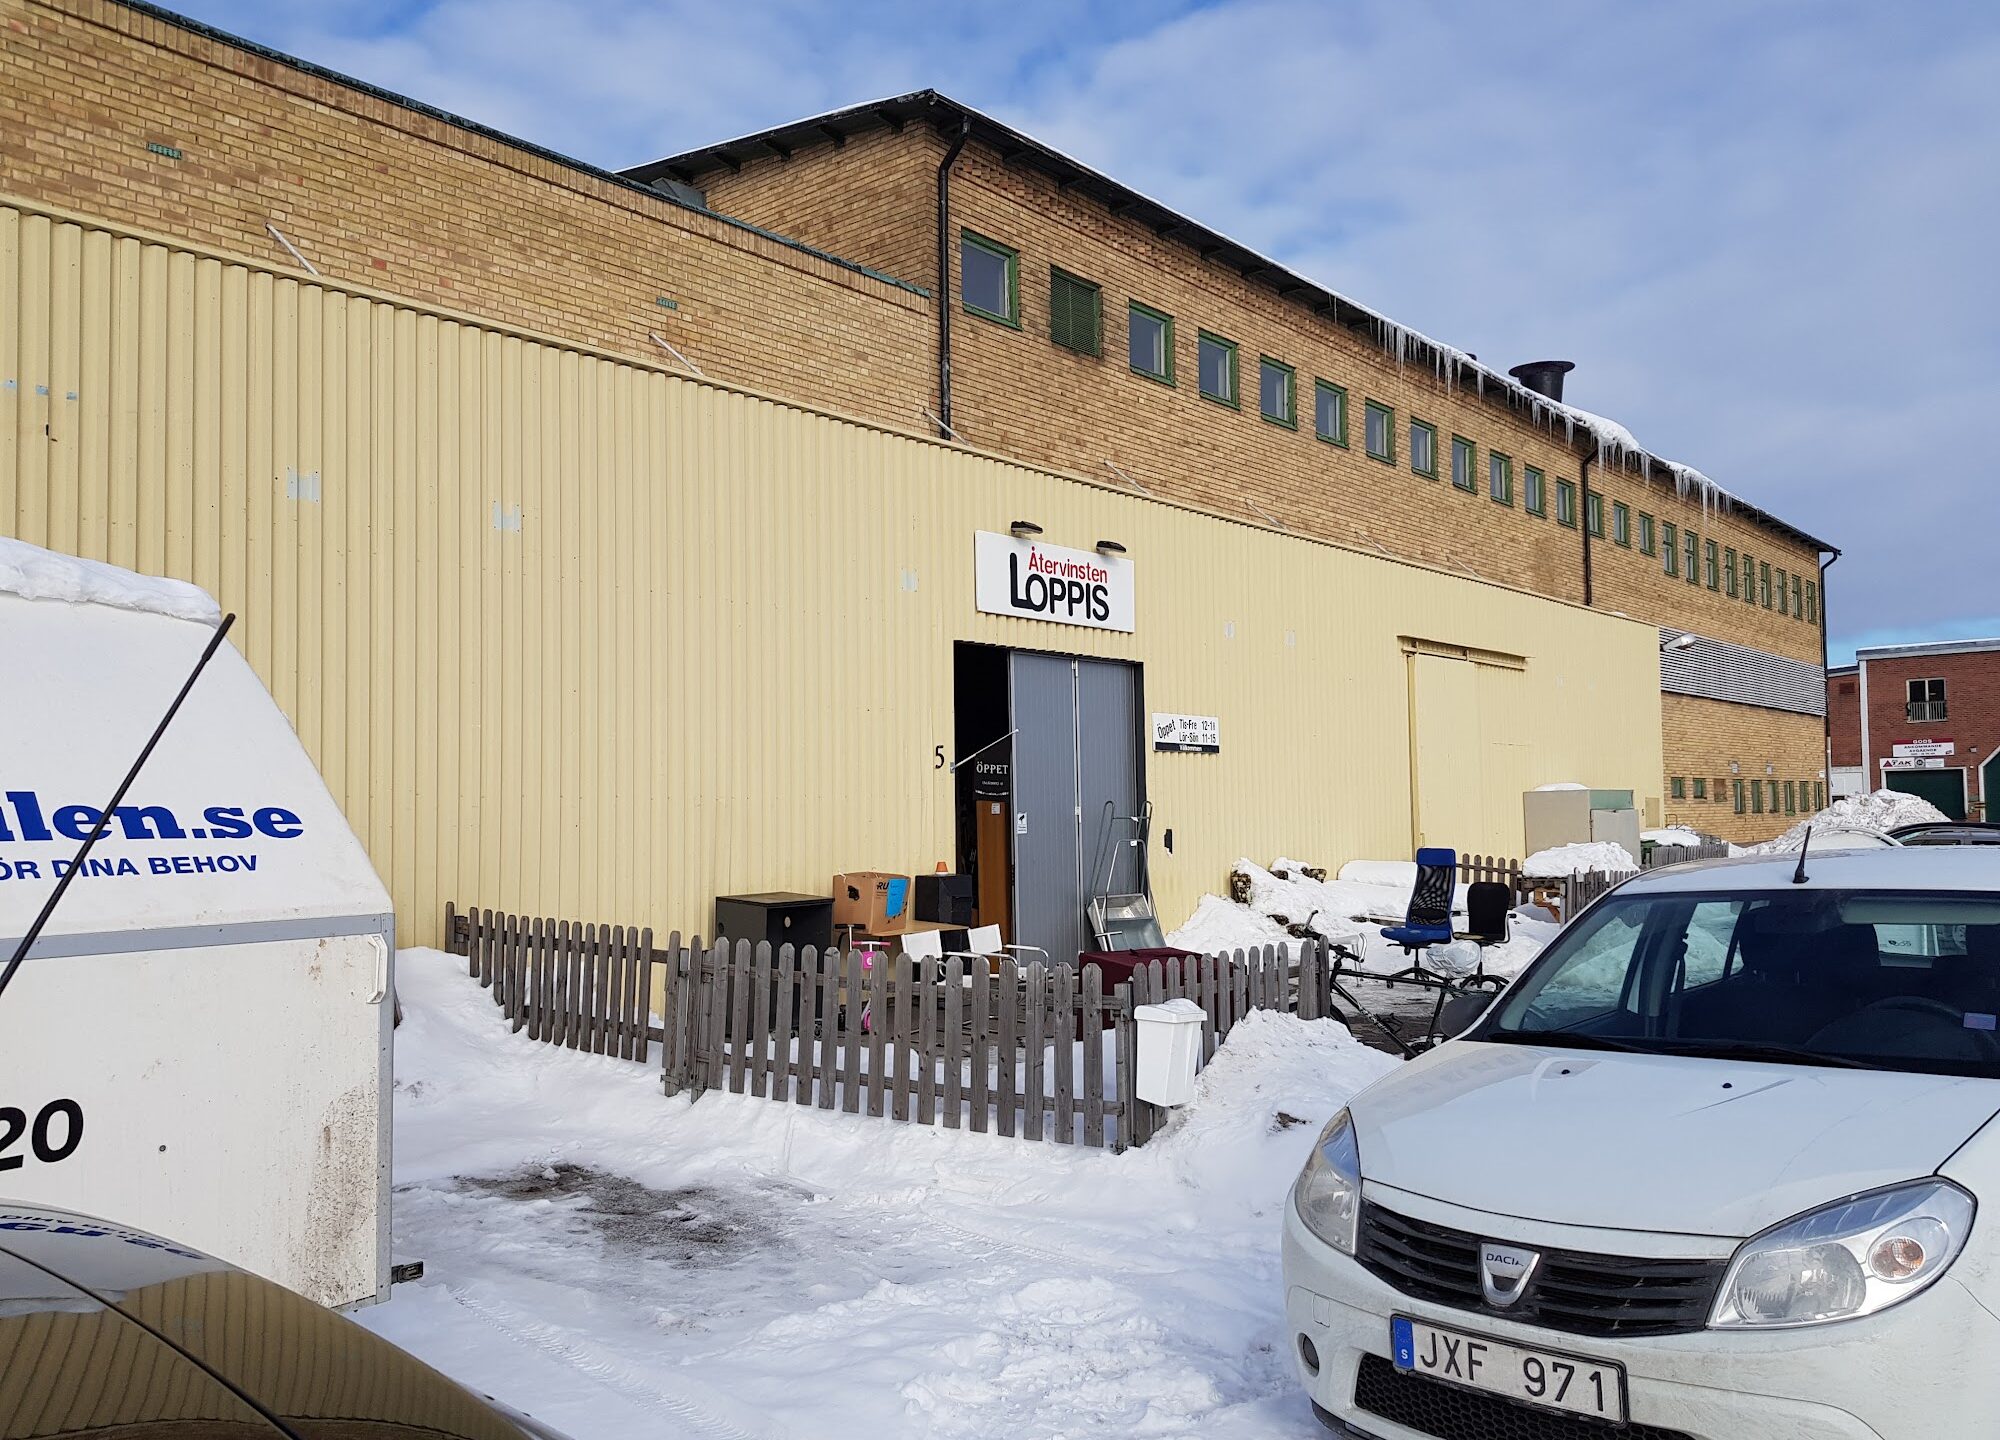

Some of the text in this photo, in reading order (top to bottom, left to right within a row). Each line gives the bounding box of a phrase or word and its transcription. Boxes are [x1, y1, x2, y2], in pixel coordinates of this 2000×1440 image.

[1028, 546, 1108, 583] Återvinsten
[1009, 552, 1110, 621] LOPPIS
[1157, 719, 1176, 739] Öppet
[1202, 733, 1216, 743] 11-15
[935, 744, 945, 770] 5
[976, 760, 1009, 775] ÖPPET
[0, 790, 304, 842] len.se
[51, 857, 140, 879] DINA
[148, 854, 258, 875] BEHOV
[1485, 1252, 1524, 1267] DACIA
[1401, 1349, 1408, 1360] S
[1420, 1332, 1604, 1413] JXF 971
